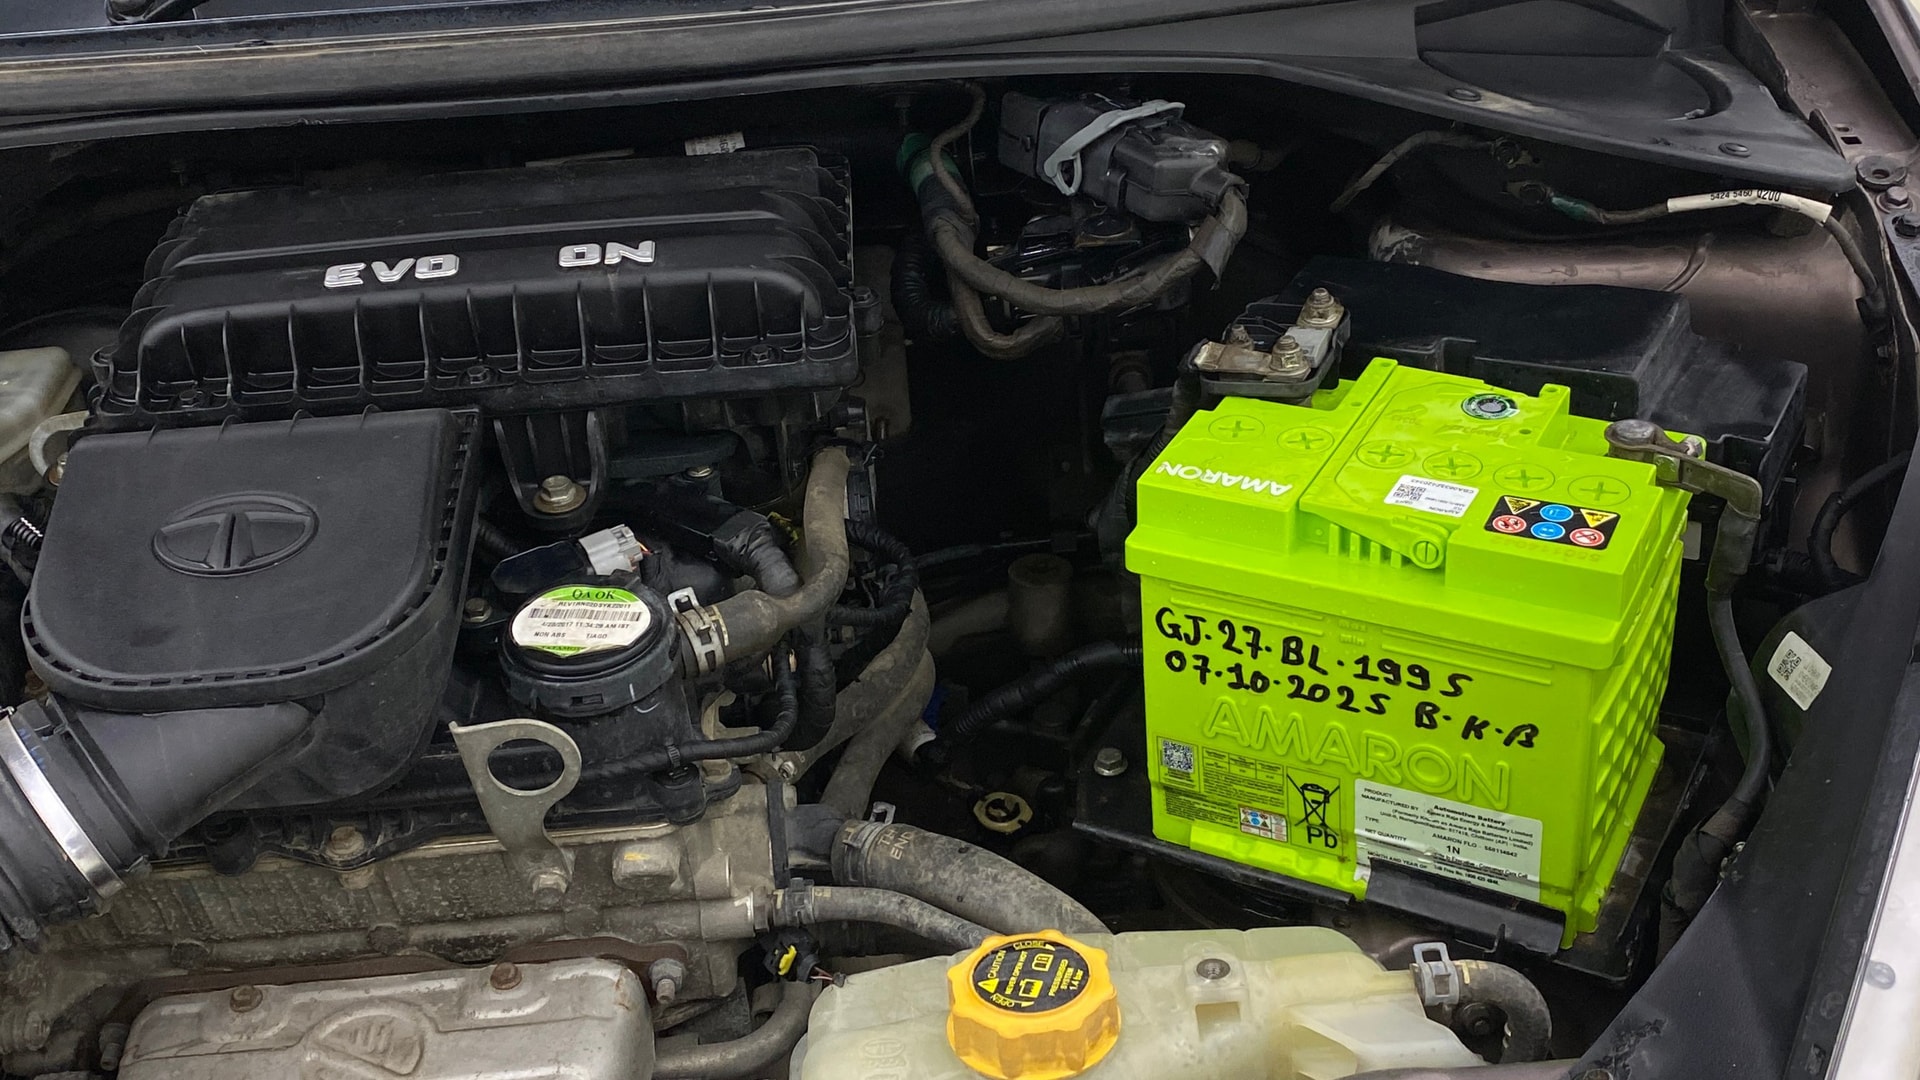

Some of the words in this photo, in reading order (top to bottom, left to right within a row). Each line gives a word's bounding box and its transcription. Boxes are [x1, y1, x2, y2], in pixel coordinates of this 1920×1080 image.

[324, 253, 460, 288] EVO
[559, 240, 655, 268] ON
[1156, 461, 1293, 496] AMARON
[595, 590, 616, 600] OK
[1204, 696, 1510, 811] AMARON
[1361, 793, 1409, 809] MANUFACTURED
[1364, 788, 1392, 798] PRODUCT
[1434, 805, 1476, 819] Automotive
[1478, 815, 1506, 826] Battery
[890, 831, 916, 860] END
[1306, 825, 1337, 849] Pb
[1377, 831, 1407, 841] QUANTITY
[1446, 845, 1460, 855] 1N
[1432, 833, 1462, 845] AMARON
[1463, 840, 1477, 848] FLO
[1403, 859, 1418, 867] YEAR
[987, 950, 1007, 979] CAUTION
